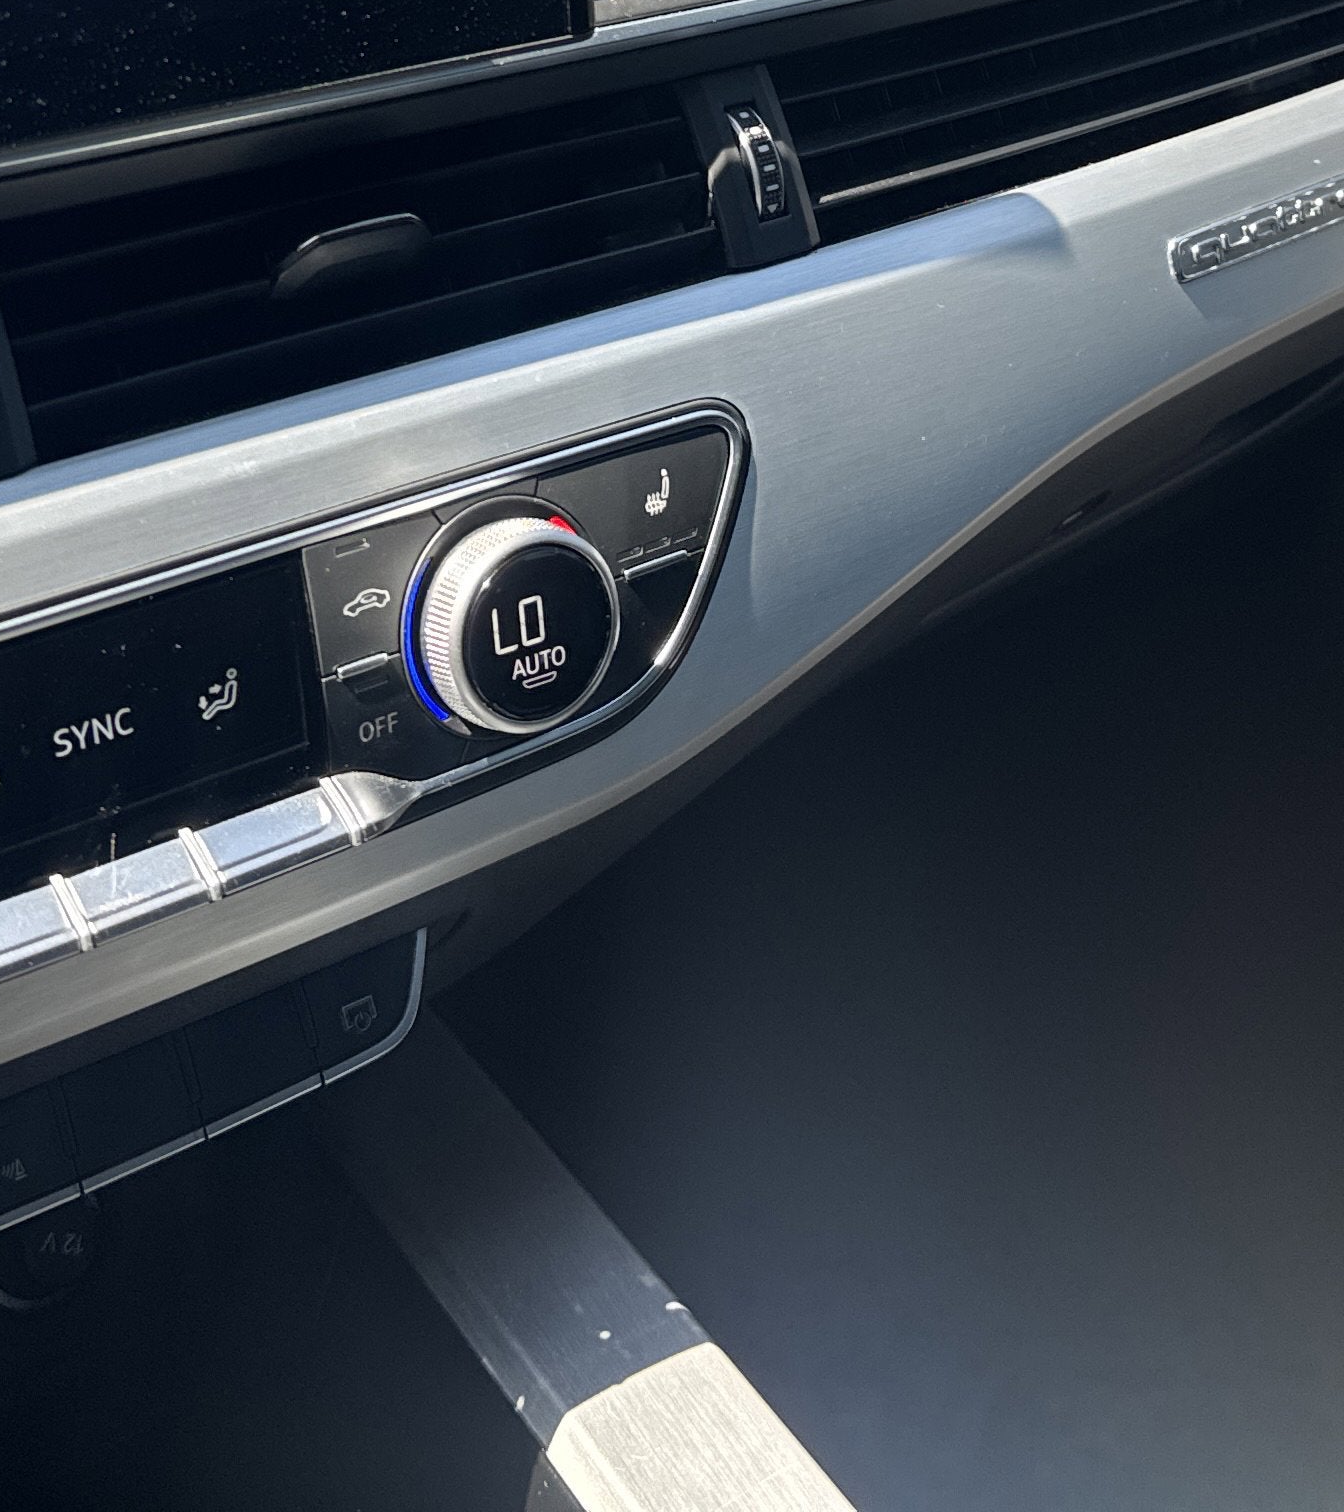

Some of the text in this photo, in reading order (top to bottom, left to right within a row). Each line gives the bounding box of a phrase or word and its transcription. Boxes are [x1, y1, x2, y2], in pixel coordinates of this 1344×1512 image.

[490, 593, 546, 656] LO
[511, 644, 567, 681] AUTO
[52, 706, 135, 758] SYNC
[358, 711, 400, 743] OFF
